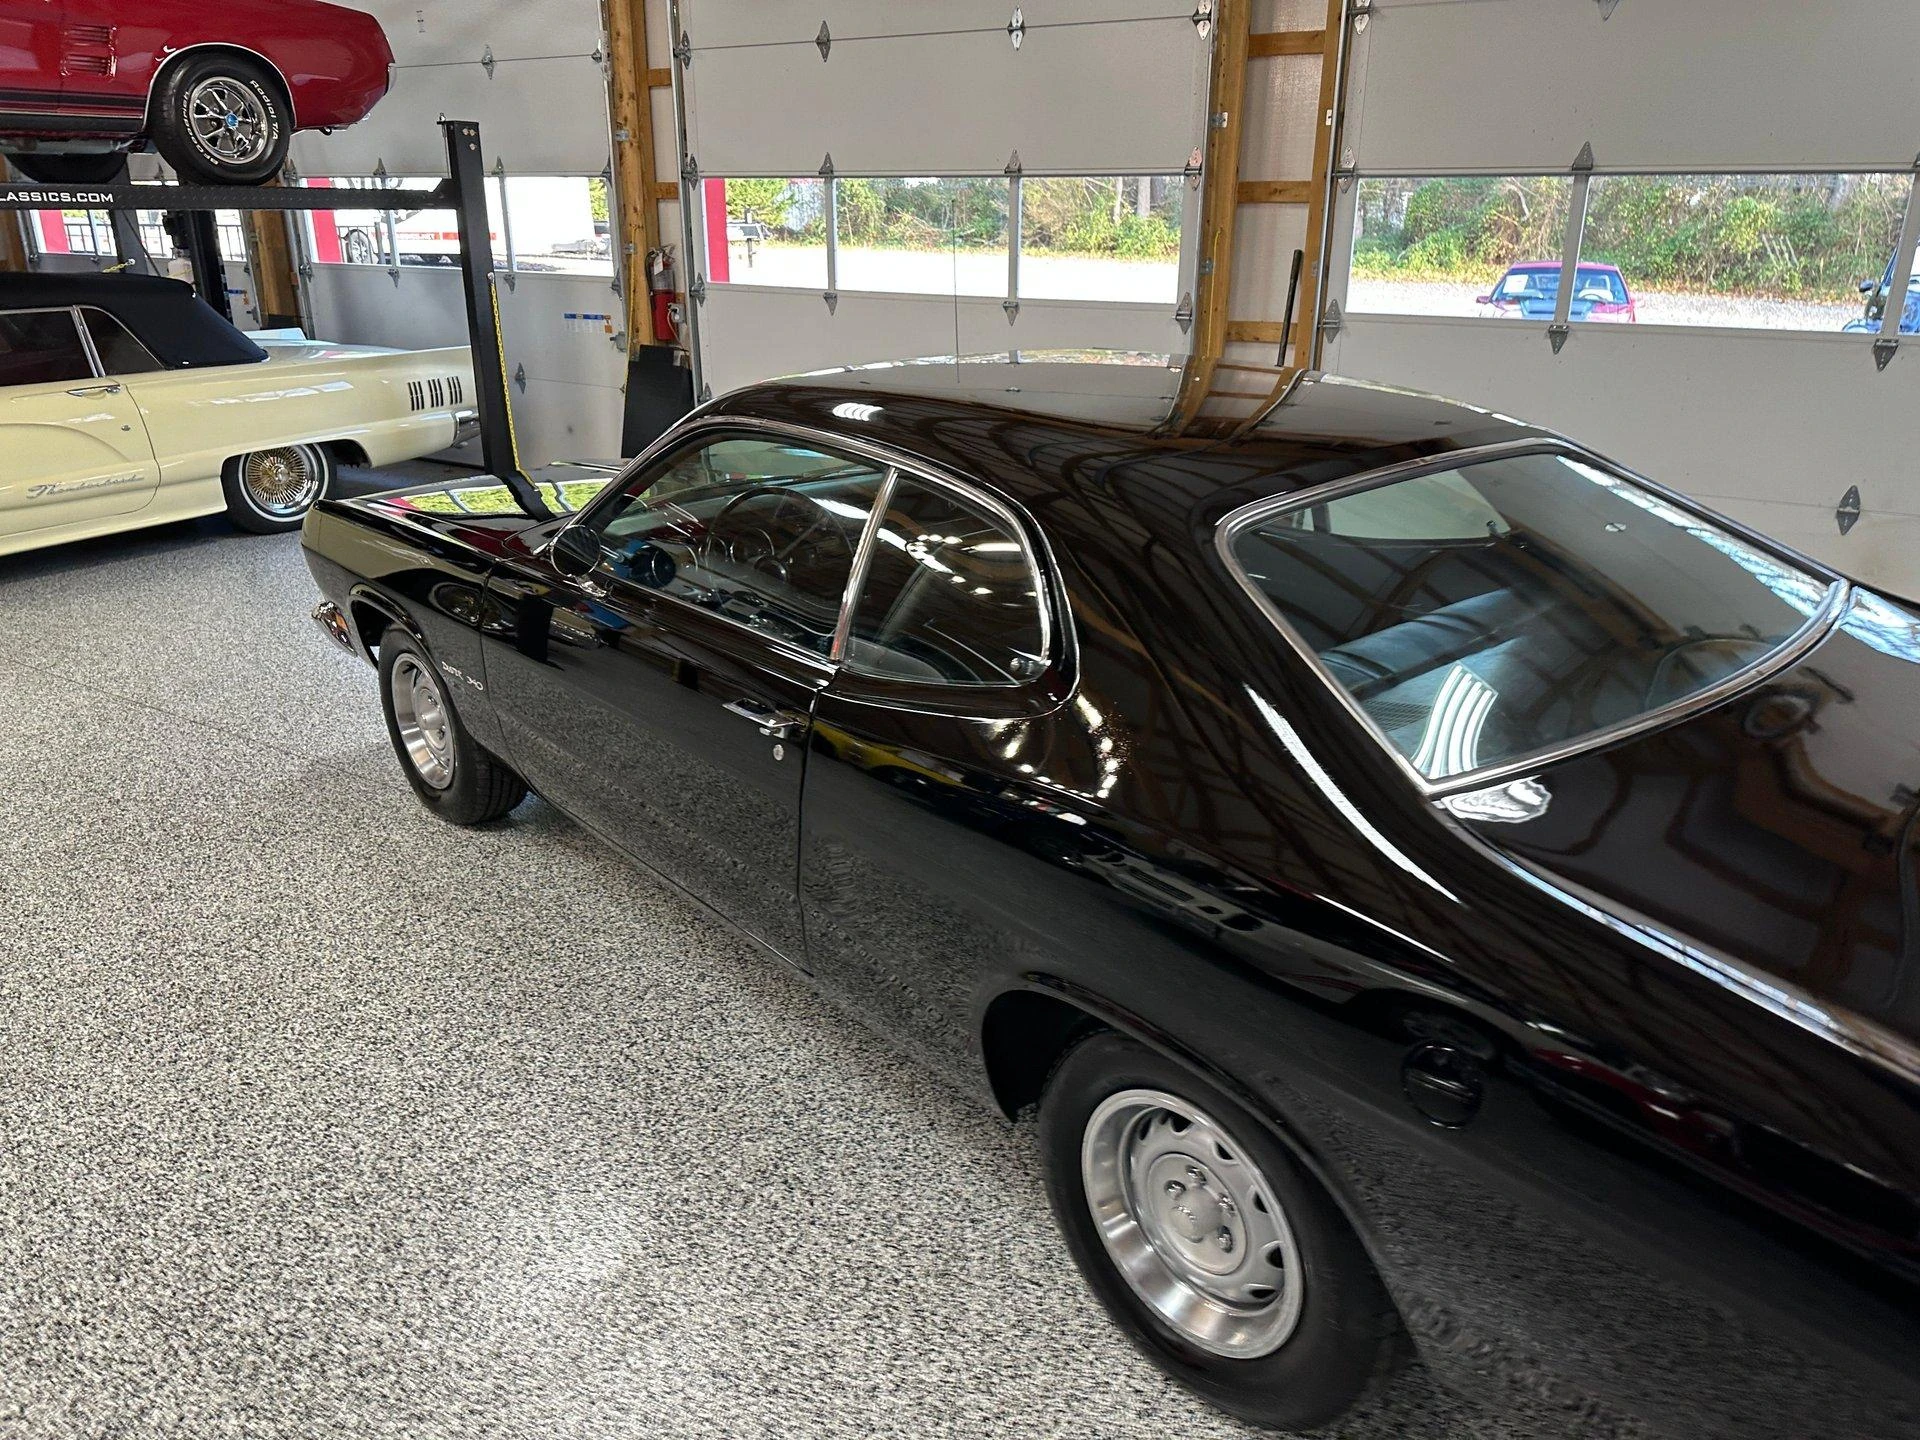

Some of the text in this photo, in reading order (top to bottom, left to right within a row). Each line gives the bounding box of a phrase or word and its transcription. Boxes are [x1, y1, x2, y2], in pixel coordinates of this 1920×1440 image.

[249, 80, 280, 140] Radial T/A
[466, 675, 484, 691] 340
